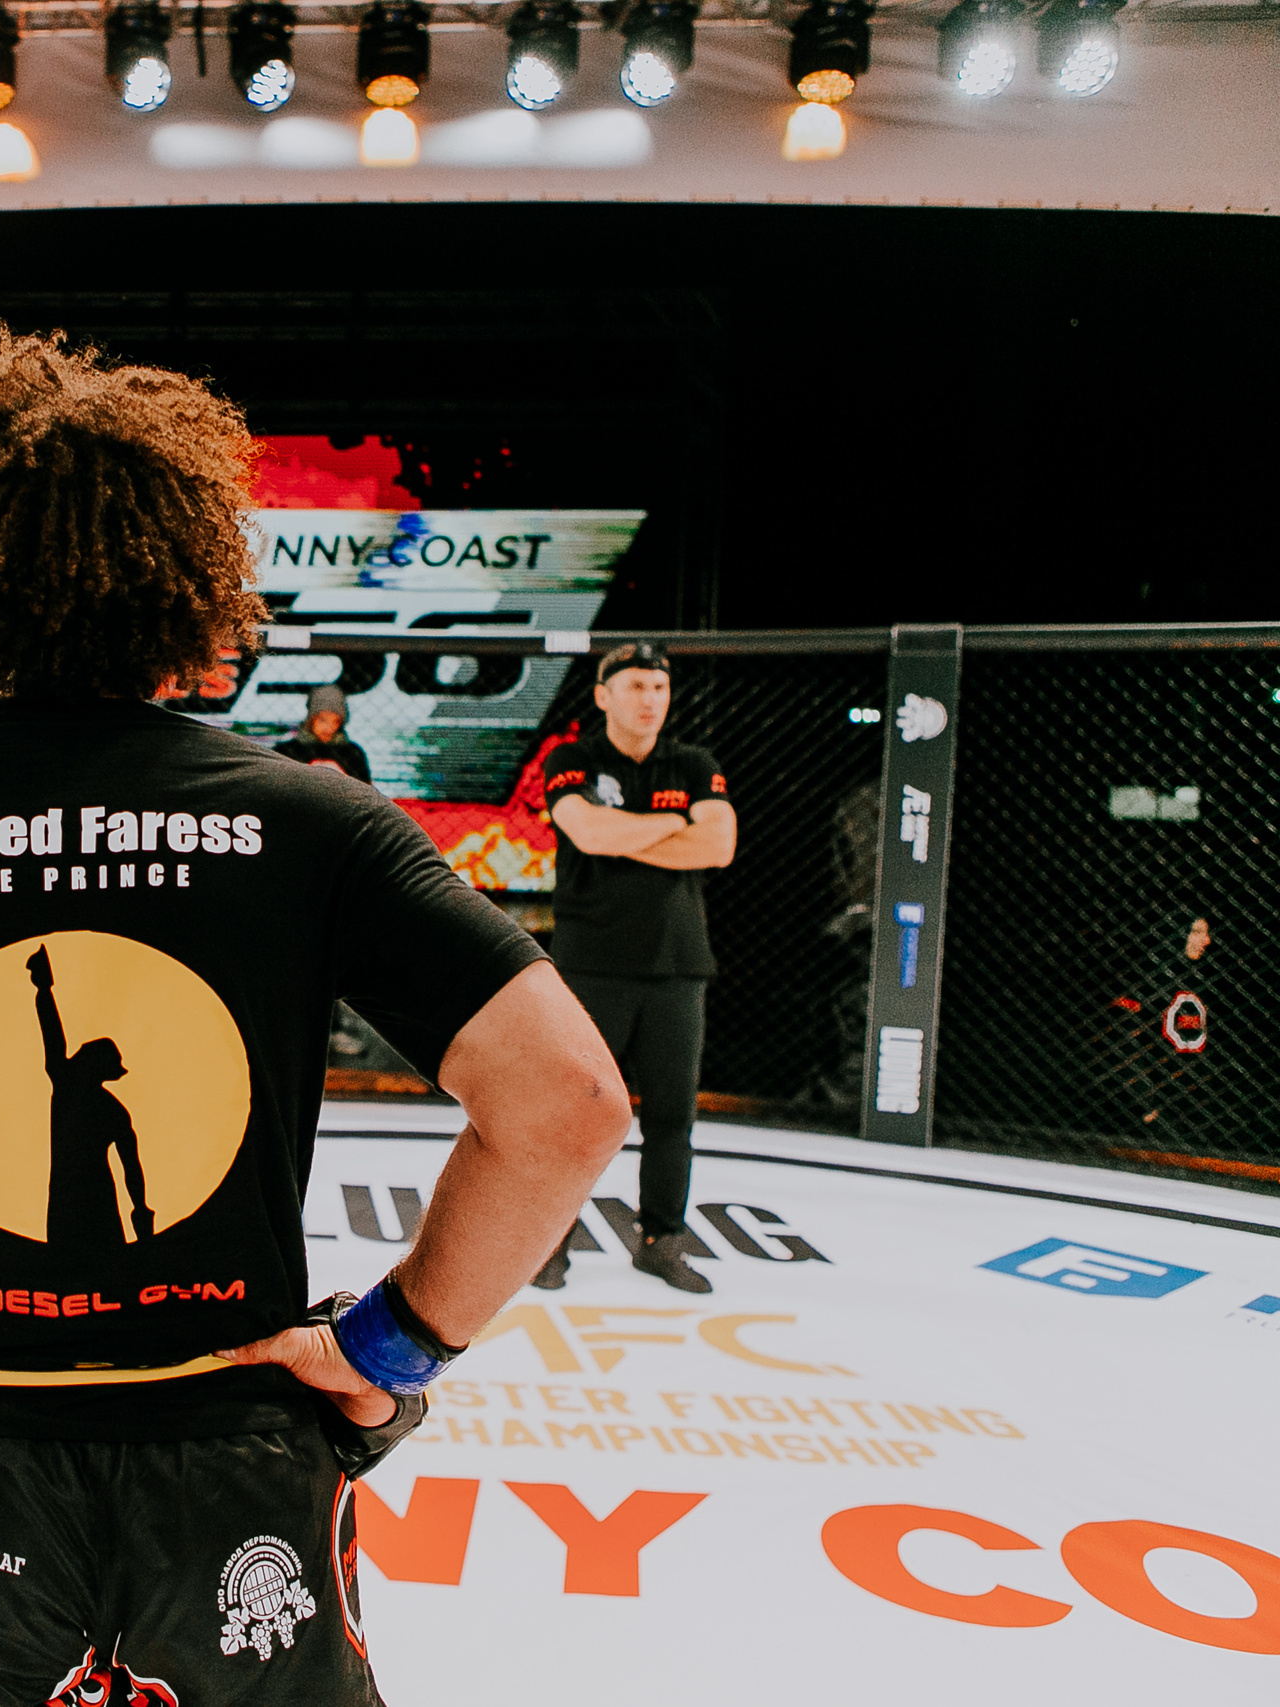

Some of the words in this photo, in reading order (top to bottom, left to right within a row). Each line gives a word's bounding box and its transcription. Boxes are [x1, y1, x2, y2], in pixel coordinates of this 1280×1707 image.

[80, 806, 262, 854] Faress
[43, 863, 190, 891] PRINCE
[139, 1279, 246, 1305] GYM
[424, 1380, 629, 1417] STER
[660, 1392, 1027, 1440] FIGHTING
